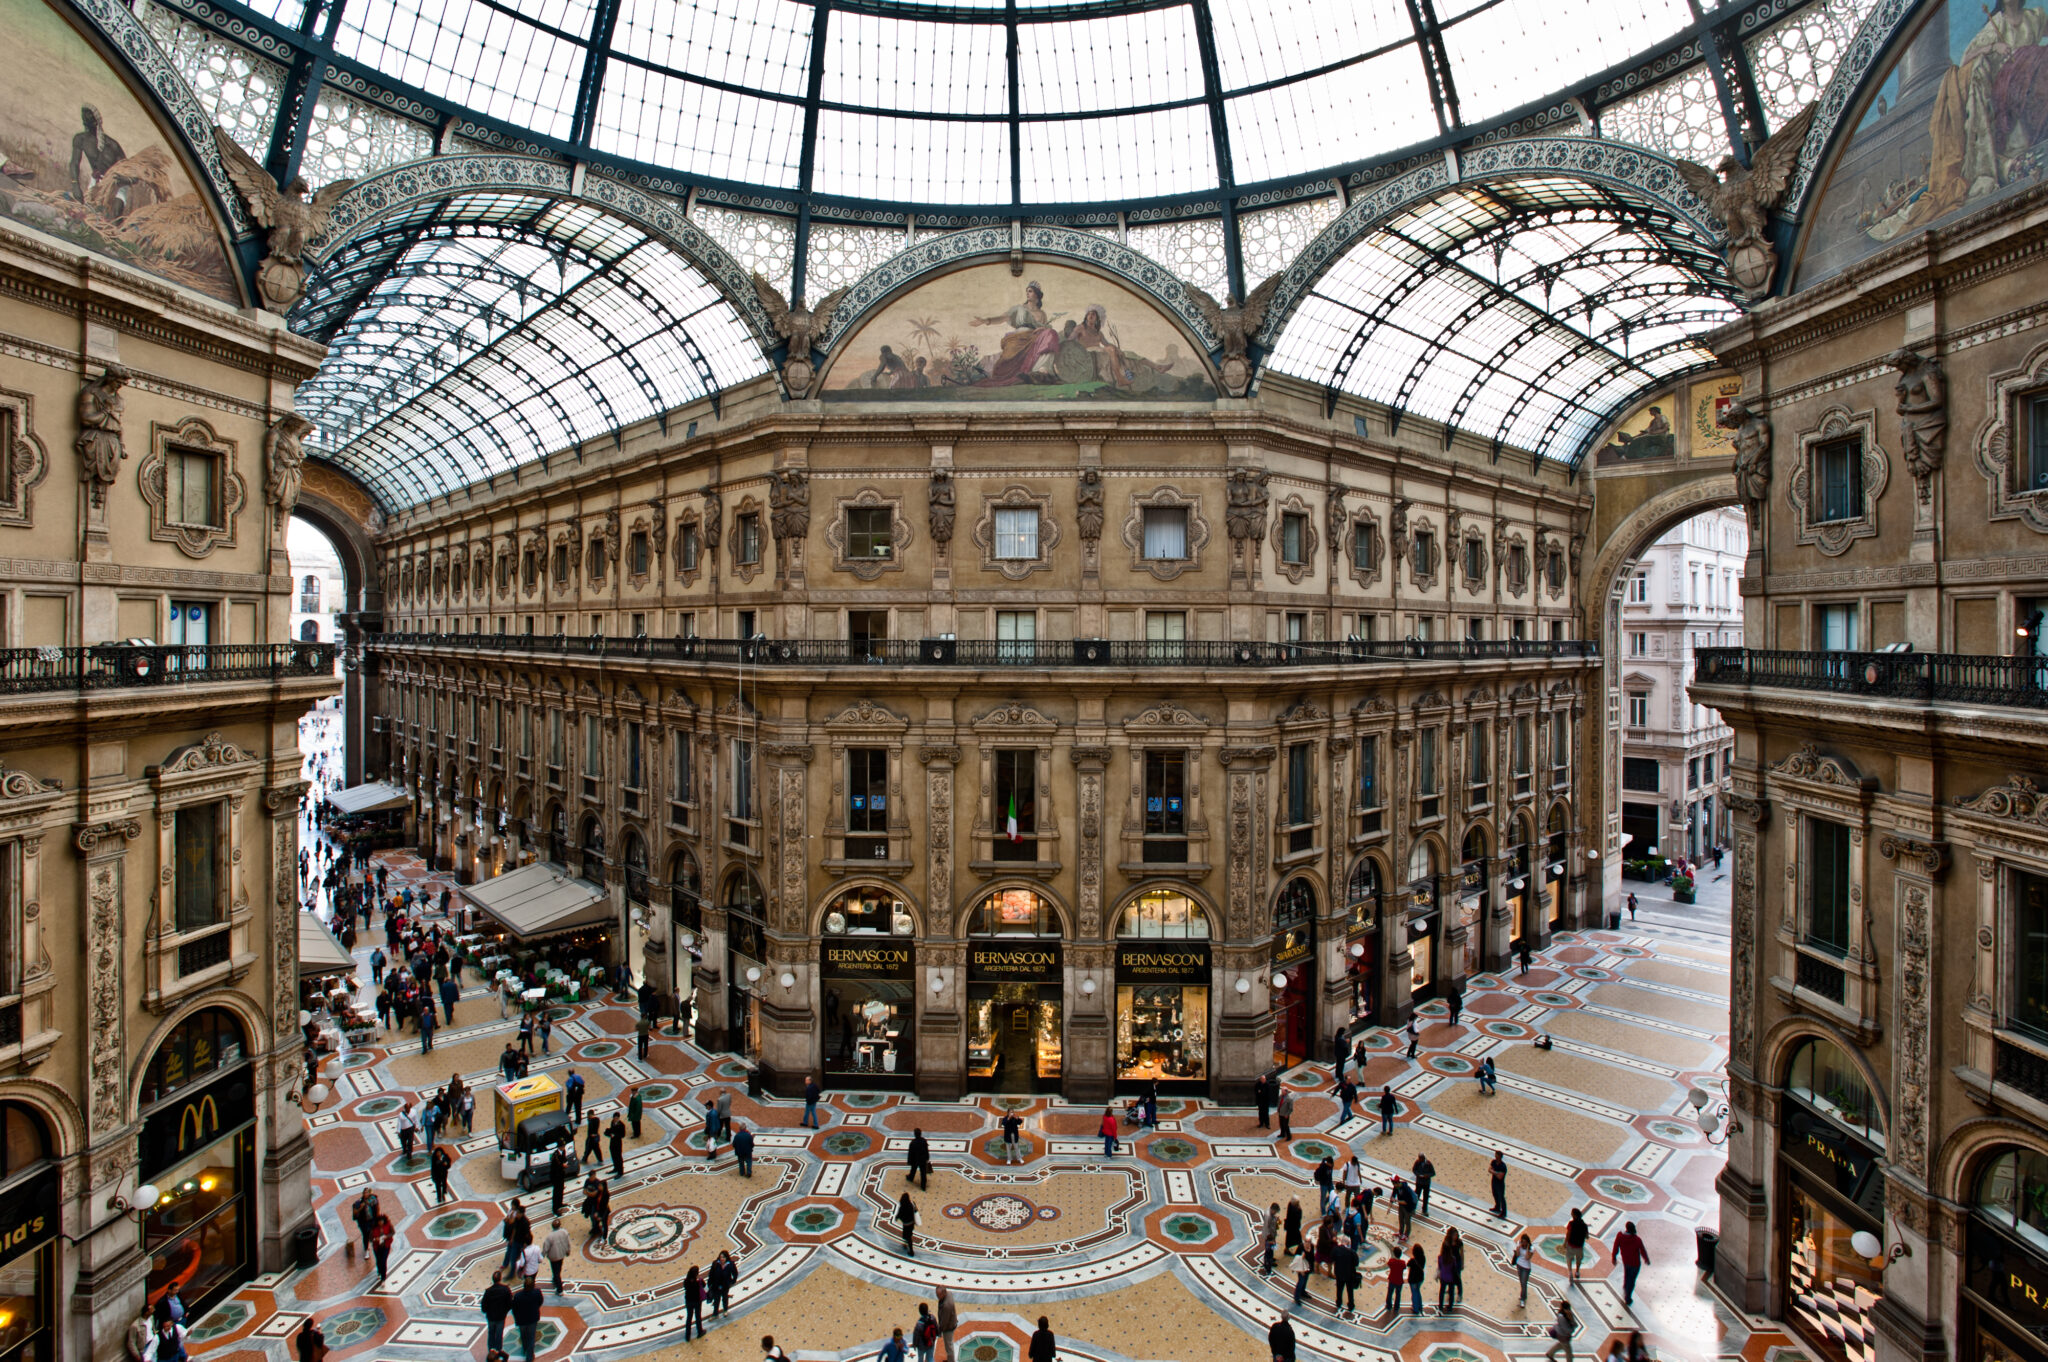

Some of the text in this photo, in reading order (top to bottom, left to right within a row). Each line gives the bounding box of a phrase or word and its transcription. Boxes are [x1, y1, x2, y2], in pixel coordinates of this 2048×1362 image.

[828, 949, 908, 963] BERNASCONI
[974, 951, 1055, 965] BERNASCONI
[1122, 953, 1204, 966] BERNASCONI
[837, 962, 872, 970] ARGENTERIA
[0, 1215, 45, 1253] ld's
